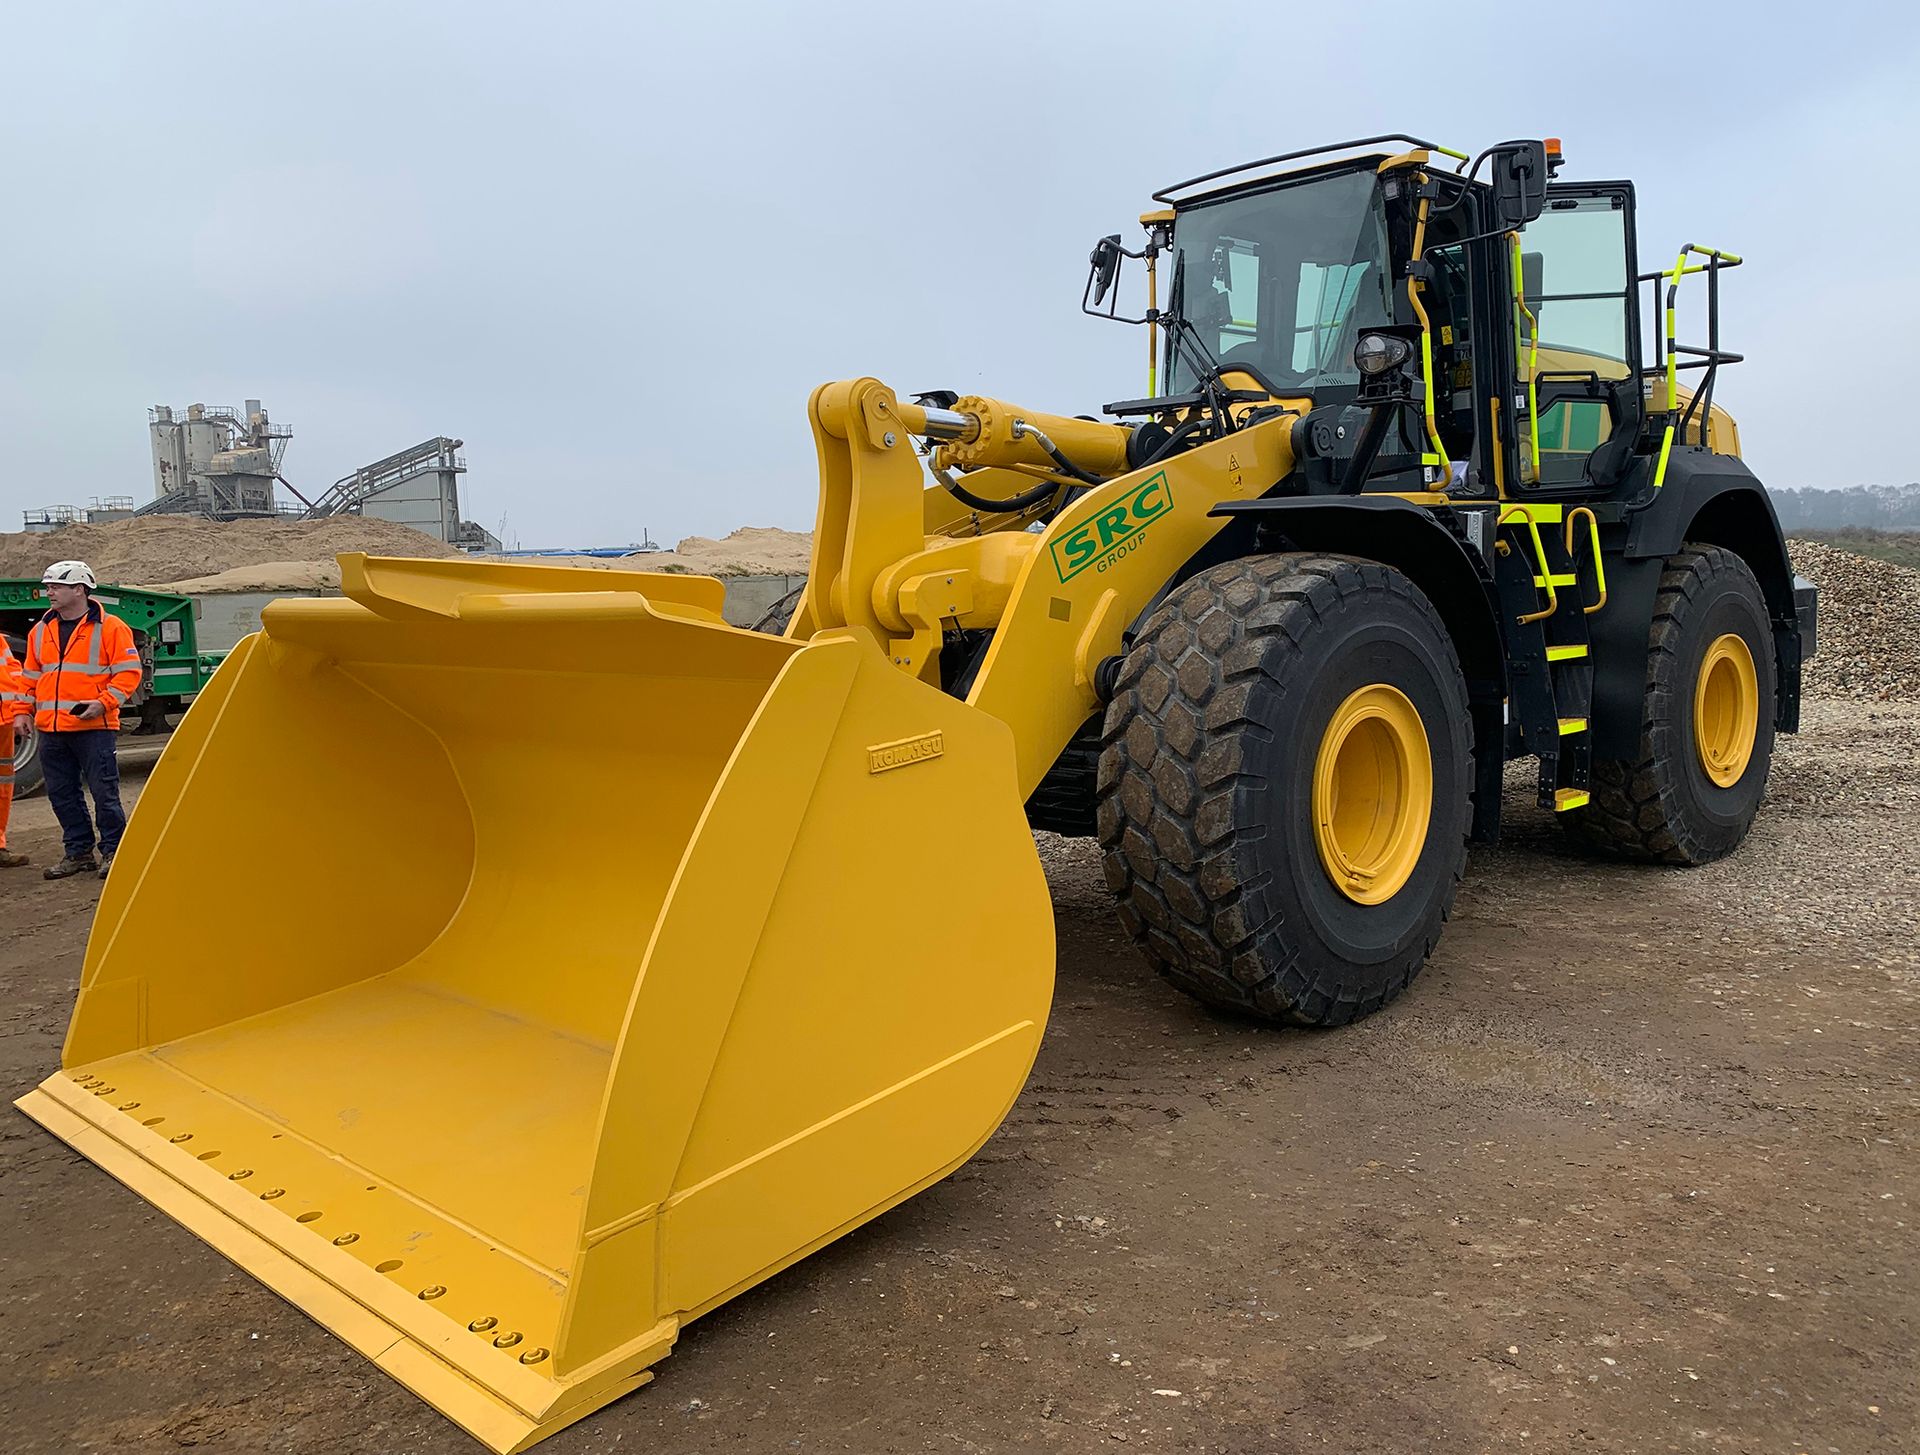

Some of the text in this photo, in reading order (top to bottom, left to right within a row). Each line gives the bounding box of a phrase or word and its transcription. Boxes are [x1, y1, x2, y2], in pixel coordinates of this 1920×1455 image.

[1064, 482, 1164, 569] SRC
[1096, 532, 1146, 573] GROUP
[872, 736, 942, 770] KOMATSU
